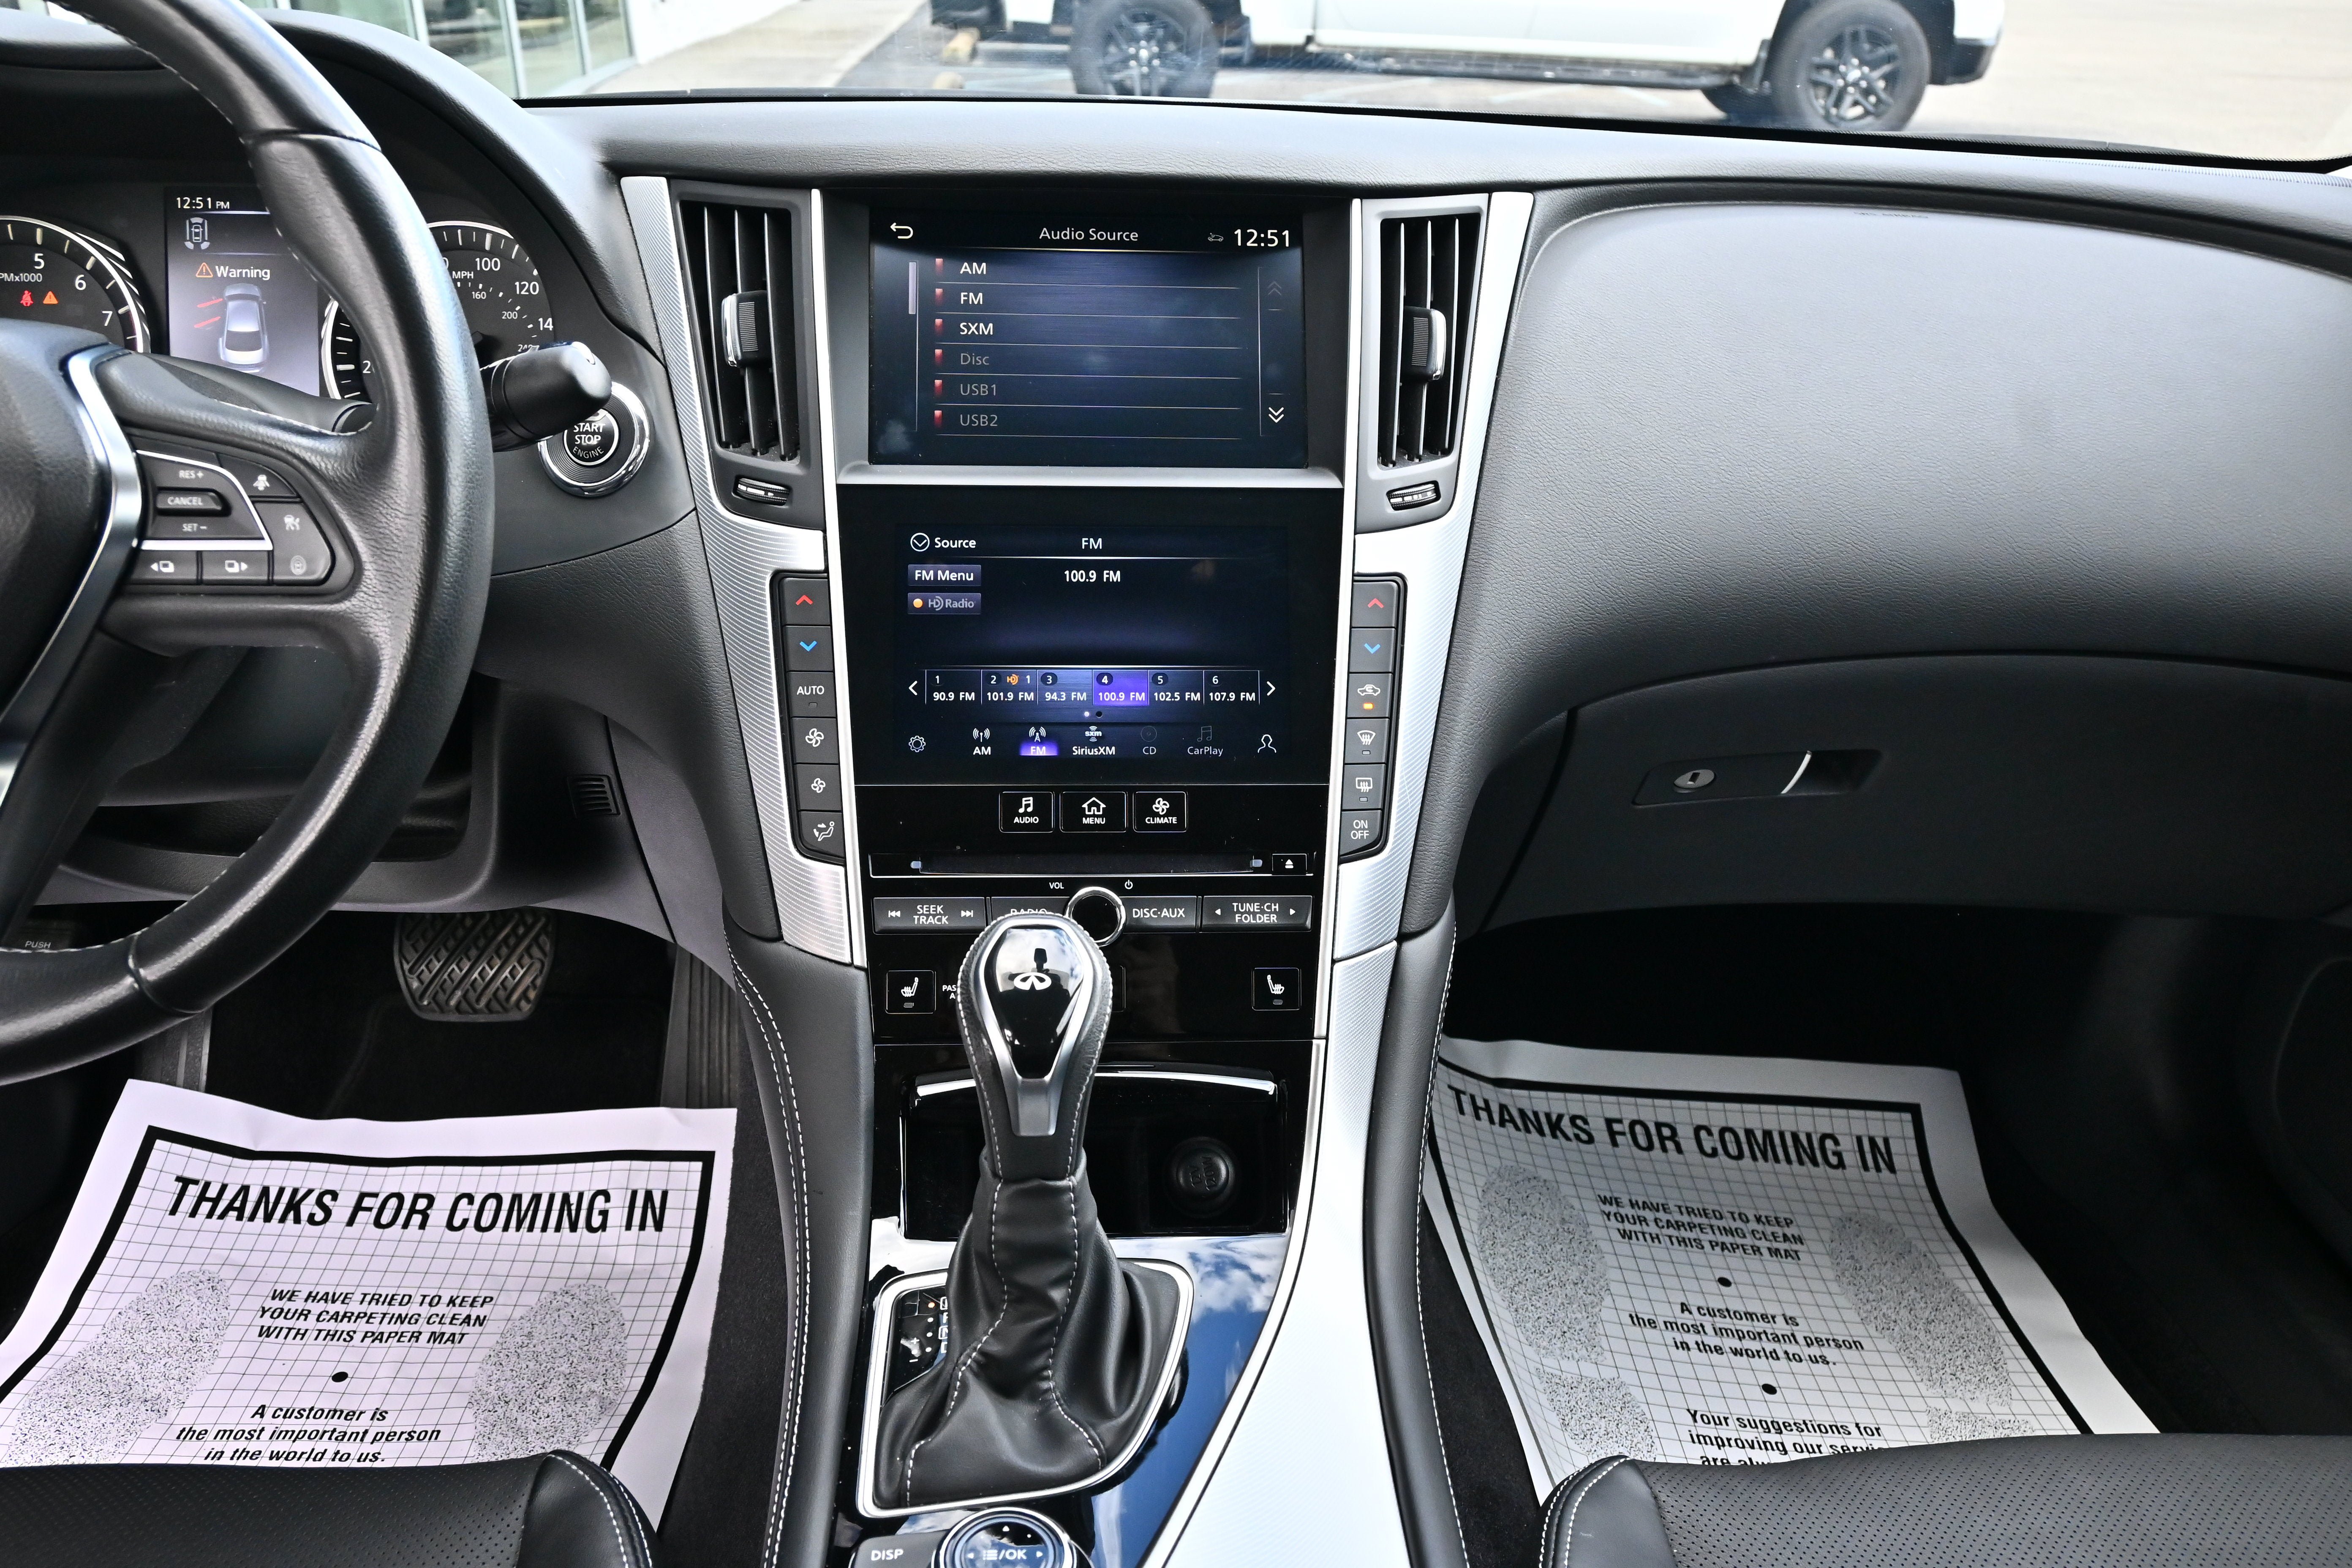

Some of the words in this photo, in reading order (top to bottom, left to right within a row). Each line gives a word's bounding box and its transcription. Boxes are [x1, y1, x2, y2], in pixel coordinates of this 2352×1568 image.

[176, 197, 212, 209] 12:51
[216, 201, 230, 209] PM
[1039, 227, 1084, 241] Audio
[1089, 228, 1138, 242] Source
[1234, 229, 1291, 248] 12:51
[34, 253, 45, 269] 5
[475, 258, 501, 271] 100
[215, 266, 271, 280] Warning
[960, 262, 987, 275] AM
[452, 271, 474, 279] MPH
[75, 274, 86, 291] 6
[514, 281, 539, 294] 120
[961, 292, 983, 305] FM
[102, 310, 113, 326] 7
[502, 311, 518, 319] 200
[960, 322, 994, 335] SXM
[961, 352, 990, 366] Disc
[960, 384, 997, 396] USB1
[960, 414, 998, 427] USB2
[573, 423, 606, 433] START
[575, 434, 601, 444] STOP
[573, 446, 604, 458] ENGINE
[168, 496, 203, 506] CANCEL
[934, 537, 976, 548] Source
[1082, 538, 1103, 550] FM
[915, 570, 934, 580] FM
[937, 570, 974, 581] Menu
[1064, 570, 1097, 583] 100.9
[1103, 570, 1121, 583] FM
[935, 675, 940, 683] 1
[991, 675, 996, 684] 2
[1026, 675, 1030, 683] 1
[1046, 675, 1052, 684] 3
[1102, 675, 1108, 684] 4
[1157, 675, 1163, 684] 5
[1212, 675, 1219, 684] 6
[797, 686, 824, 695] AUTO
[933, 692, 954, 701] 90.9
[960, 692, 975, 701] FM
[987, 692, 1013, 701] 101.9
[1019, 692, 1034, 701] FM
[1045, 692, 1066, 701] 94.3
[1072, 692, 1086, 701] FM
[1098, 692, 1124, 701] 100.9
[1130, 692, 1145, 701] FM
[1154, 692, 1180, 701] 102.5
[1185, 692, 1200, 701] FM
[1209, 692, 1235, 701] 107.9
[1241, 692, 1255, 701] FM
[973, 746, 991, 755] AM
[1031, 746, 1046, 755] FM
[1073, 746, 1116, 755] SiriusXM
[1143, 746, 1157, 755] CD
[1187, 746, 1223, 757] CarPlay
[1353, 820, 1368, 829] ON
[1351, 830, 1369, 840] OFF
[917, 905, 944, 914] SEEK
[913, 915, 949, 924] TRACK
[1236, 914, 1277, 923] FOLDER
[1447, 1084, 1595, 1146] THANKS
[1605, 1117, 1683, 1154] FOR
[1694, 1124, 1846, 1170] COMING
[1857, 1134, 1897, 1174] IN
[168, 1176, 338, 1226] THANKS
[346, 1192, 436, 1230] FOR
[446, 1190, 611, 1233] COMING
[625, 1190, 668, 1232] IN
[1598, 1195, 1624, 1208] WE
[1629, 1199, 1671, 1214] HAVE
[1675, 1204, 1723, 1221] TRIED
[1727, 1211, 1750, 1224] TO
[1754, 1214, 1794, 1228] KEEP
[1602, 1210, 1648, 1226] YOUR
[1654, 1217, 1746, 1238] CARPETING
[1752, 1229, 1805, 1246] CLEAN
[1617, 1228, 1662, 1244] WITH
[1663, 1235, 1705, 1250] THIS
[1709, 1240, 1763, 1256] PAPER
[1767, 1247, 1801, 1261] MAT
[271, 1289, 301, 1302] WE
[304, 1291, 354, 1305] HAVE
[359, 1293, 412, 1307] TRIED
[419, 1294, 442, 1308] TO
[446, 1296, 493, 1308] KEEP
[259, 1307, 312, 1322] YOUR
[316, 1310, 422, 1326] CARPETING
[426, 1313, 487, 1327] CLEAN
[1680, 1302, 1693, 1315] A
[1697, 1305, 1777, 1324] customer
[1783, 1314, 1799, 1327] is
[257, 1326, 308, 1341] WITH
[313, 1328, 356, 1343] THIS
[360, 1330, 422, 1344] PAPER
[426, 1331, 469, 1345] MAT
[1629, 1313, 1658, 1329] the
[1663, 1320, 1709, 1336] most
[1711, 1324, 1799, 1345] important
[1803, 1335, 1865, 1350] person
[1673, 1337, 1691, 1352] in
[1695, 1341, 1724, 1356] the
[1729, 1346, 1780, 1362] world
[1786, 1350, 1803, 1364] to
[1808, 1354, 1837, 1366] us.
[250, 1405, 267, 1418] A
[271, 1406, 366, 1421] customer
[370, 1407, 389, 1421] is
[1687, 1409, 1729, 1428] Your
[1737, 1415, 1852, 1436] suggestions
[1855, 1423, 1882, 1437] for
[176, 1427, 208, 1440] the
[214, 1427, 264, 1440] most
[270, 1427, 368, 1443] important
[370, 1428, 441, 1444] person
[1688, 1430, 1788, 1455] improving
[1793, 1441, 1823, 1455] our
[204, 1448, 225, 1461] in
[230, 1448, 262, 1461] the
[269, 1448, 328, 1462] world
[334, 1450, 349, 1462] to
[356, 1451, 385, 1463] us.
[871, 1549, 904, 1561] DISP
